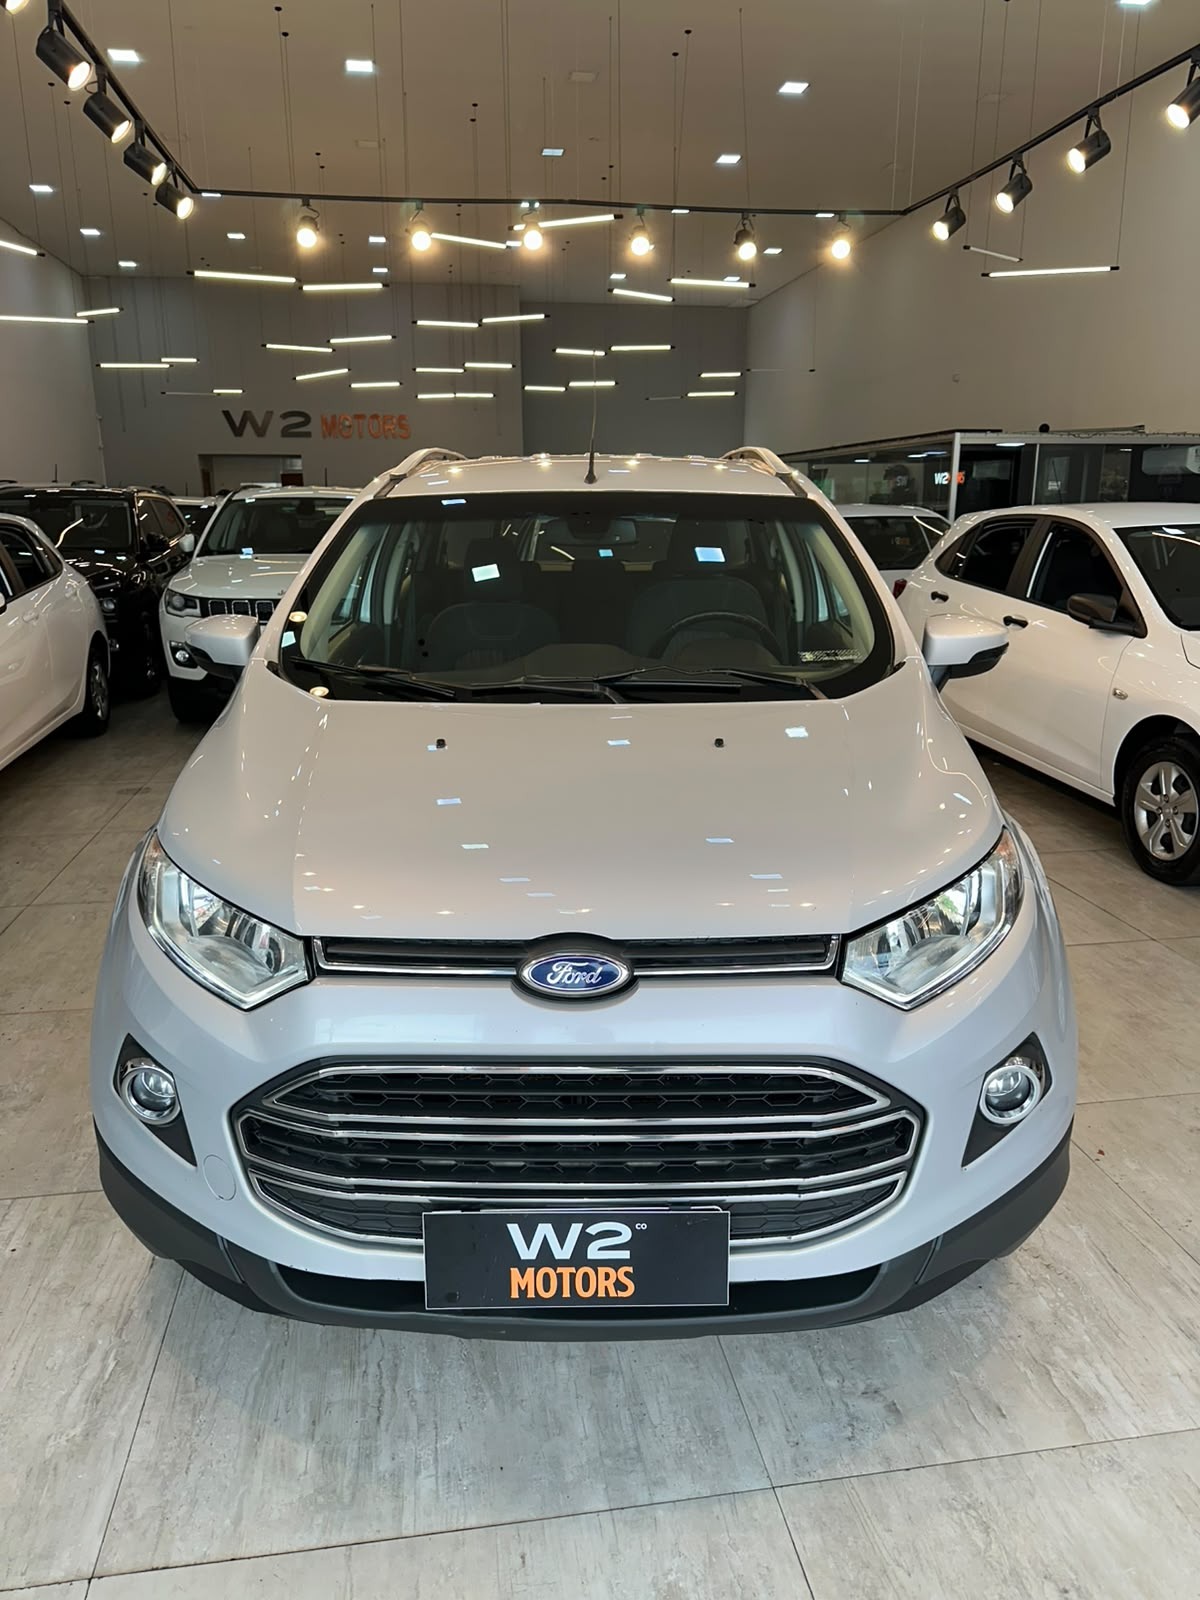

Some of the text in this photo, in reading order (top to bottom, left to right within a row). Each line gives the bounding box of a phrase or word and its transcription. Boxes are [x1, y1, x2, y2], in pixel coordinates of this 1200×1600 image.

[221, 410, 411, 440] W2 MOTORS
[546, 961, 602, 985] Ford
[506, 1221, 633, 1260] W2
[510, 1266, 636, 1300] MOTORS
